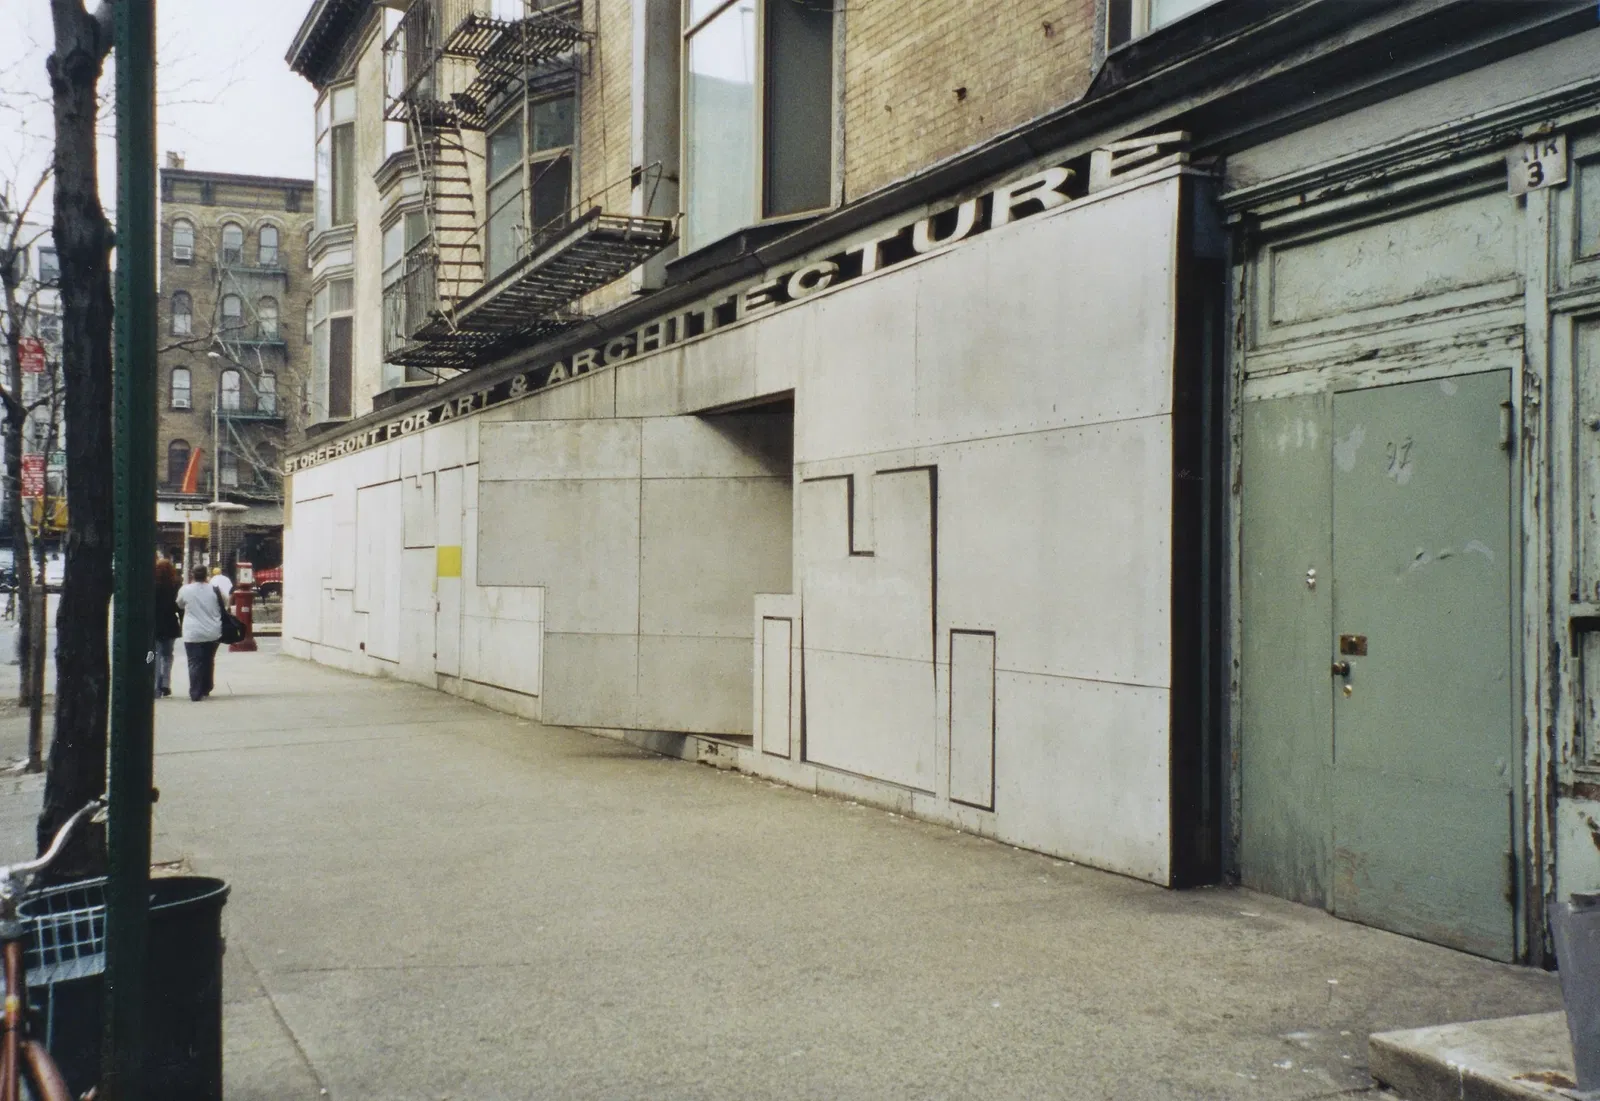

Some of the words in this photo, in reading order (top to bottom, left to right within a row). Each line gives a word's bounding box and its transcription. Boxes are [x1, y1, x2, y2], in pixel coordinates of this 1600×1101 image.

[1527, 160, 1545, 187] 3
[284, 428, 382, 473] STOREFRONT
[386, 410, 432, 441] FOR
[439, 387, 496, 422] ART
[509, 373, 528, 398] &
[545, 130, 1190, 386] ARCHITECTURE
